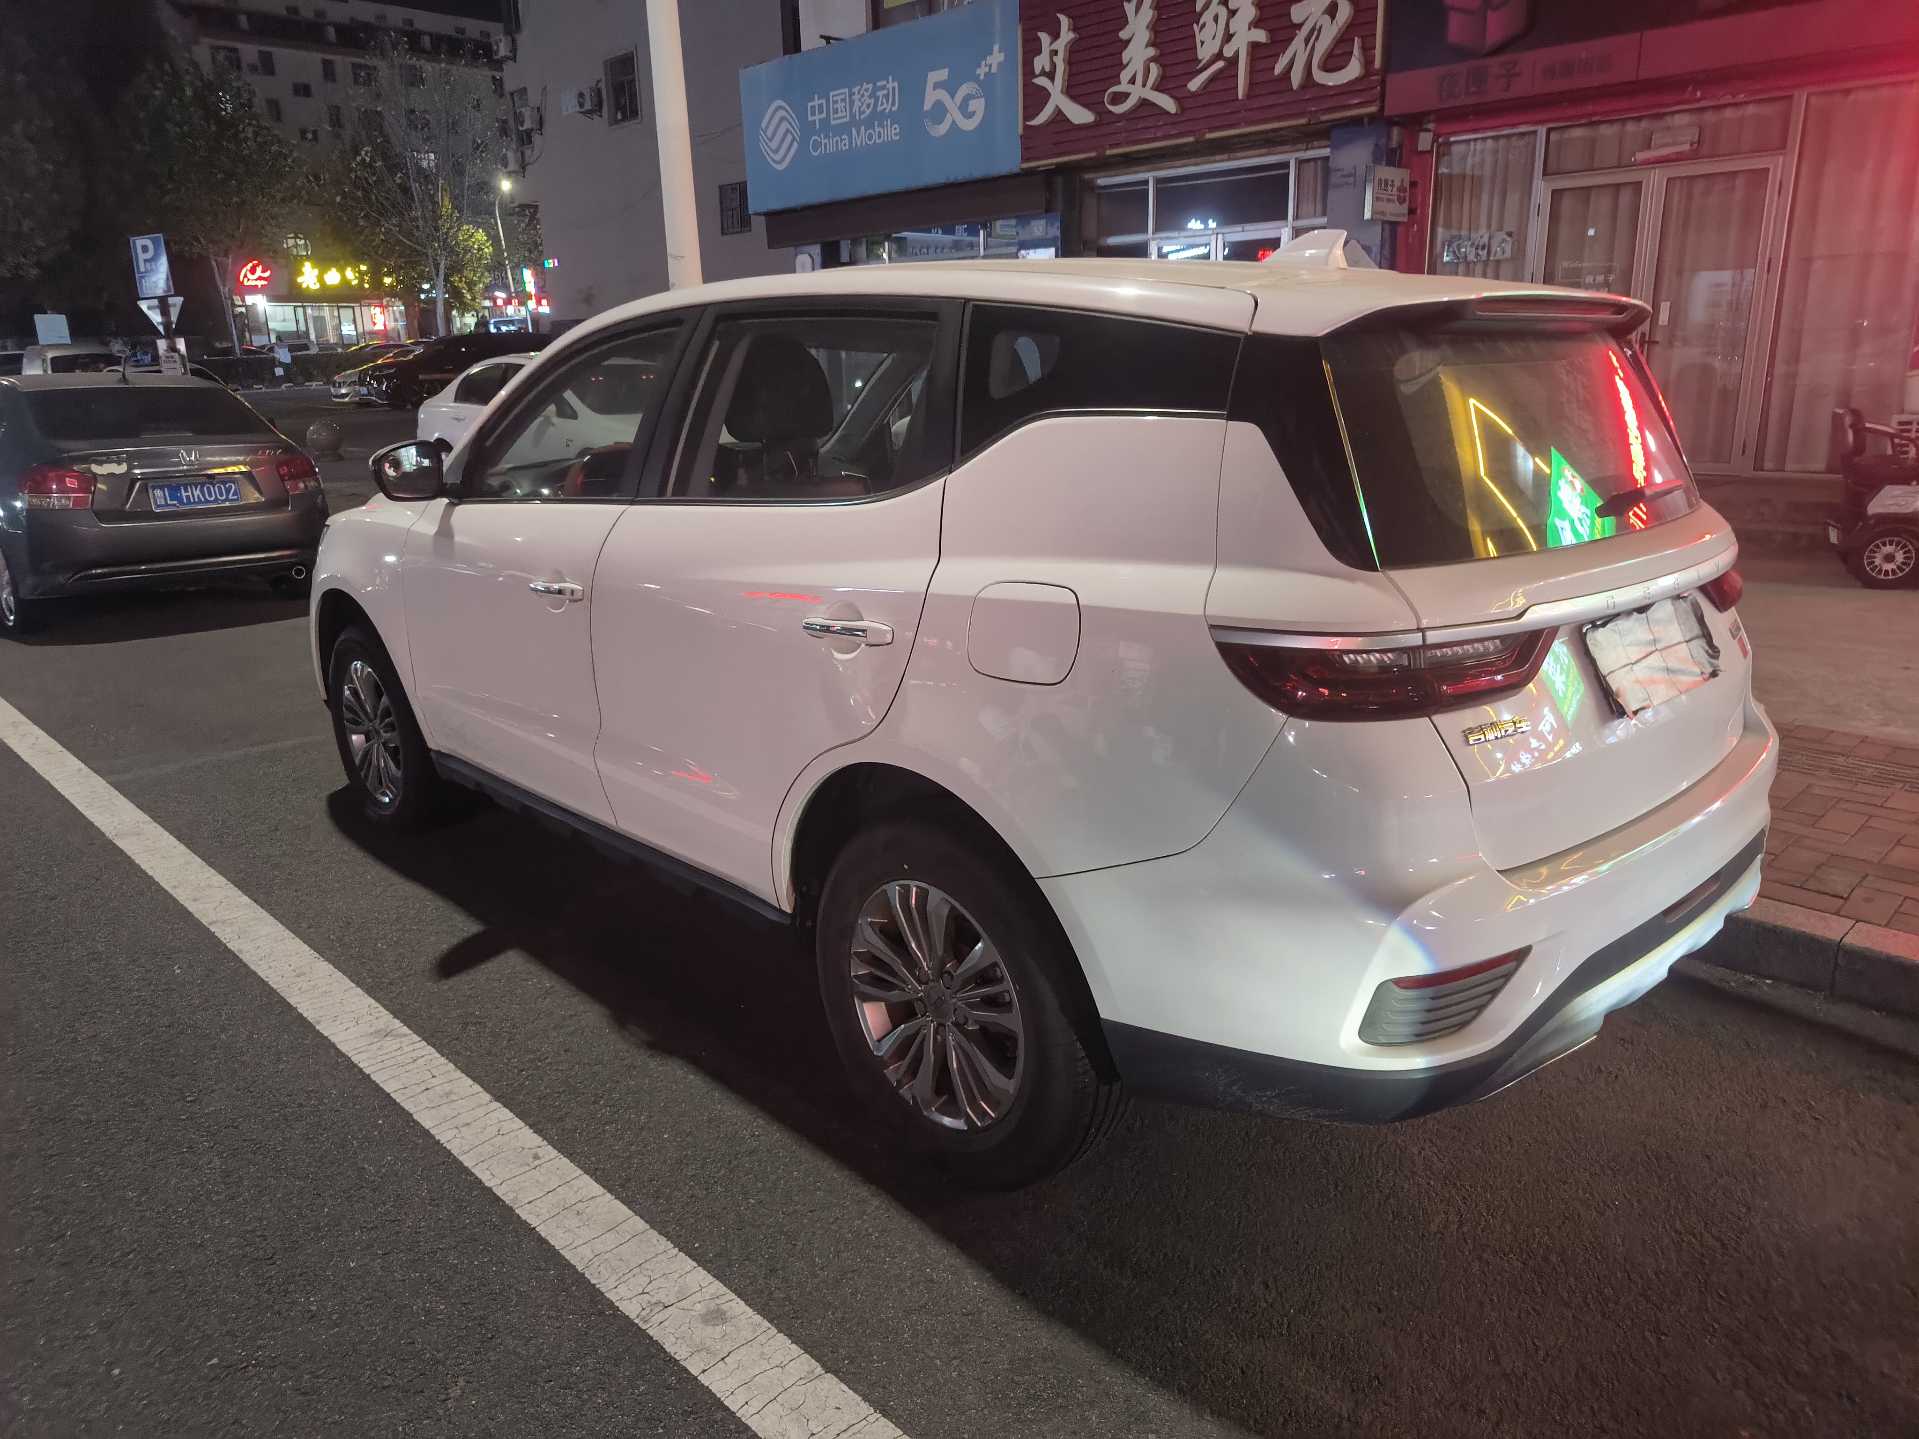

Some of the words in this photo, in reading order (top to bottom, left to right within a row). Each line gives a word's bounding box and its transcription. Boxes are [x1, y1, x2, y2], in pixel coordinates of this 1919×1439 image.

[807, 76, 899, 129] 中国移动
[809, 131, 849, 156] China
[852, 119, 901, 149] Mobile
[135, 238, 154, 272] P
